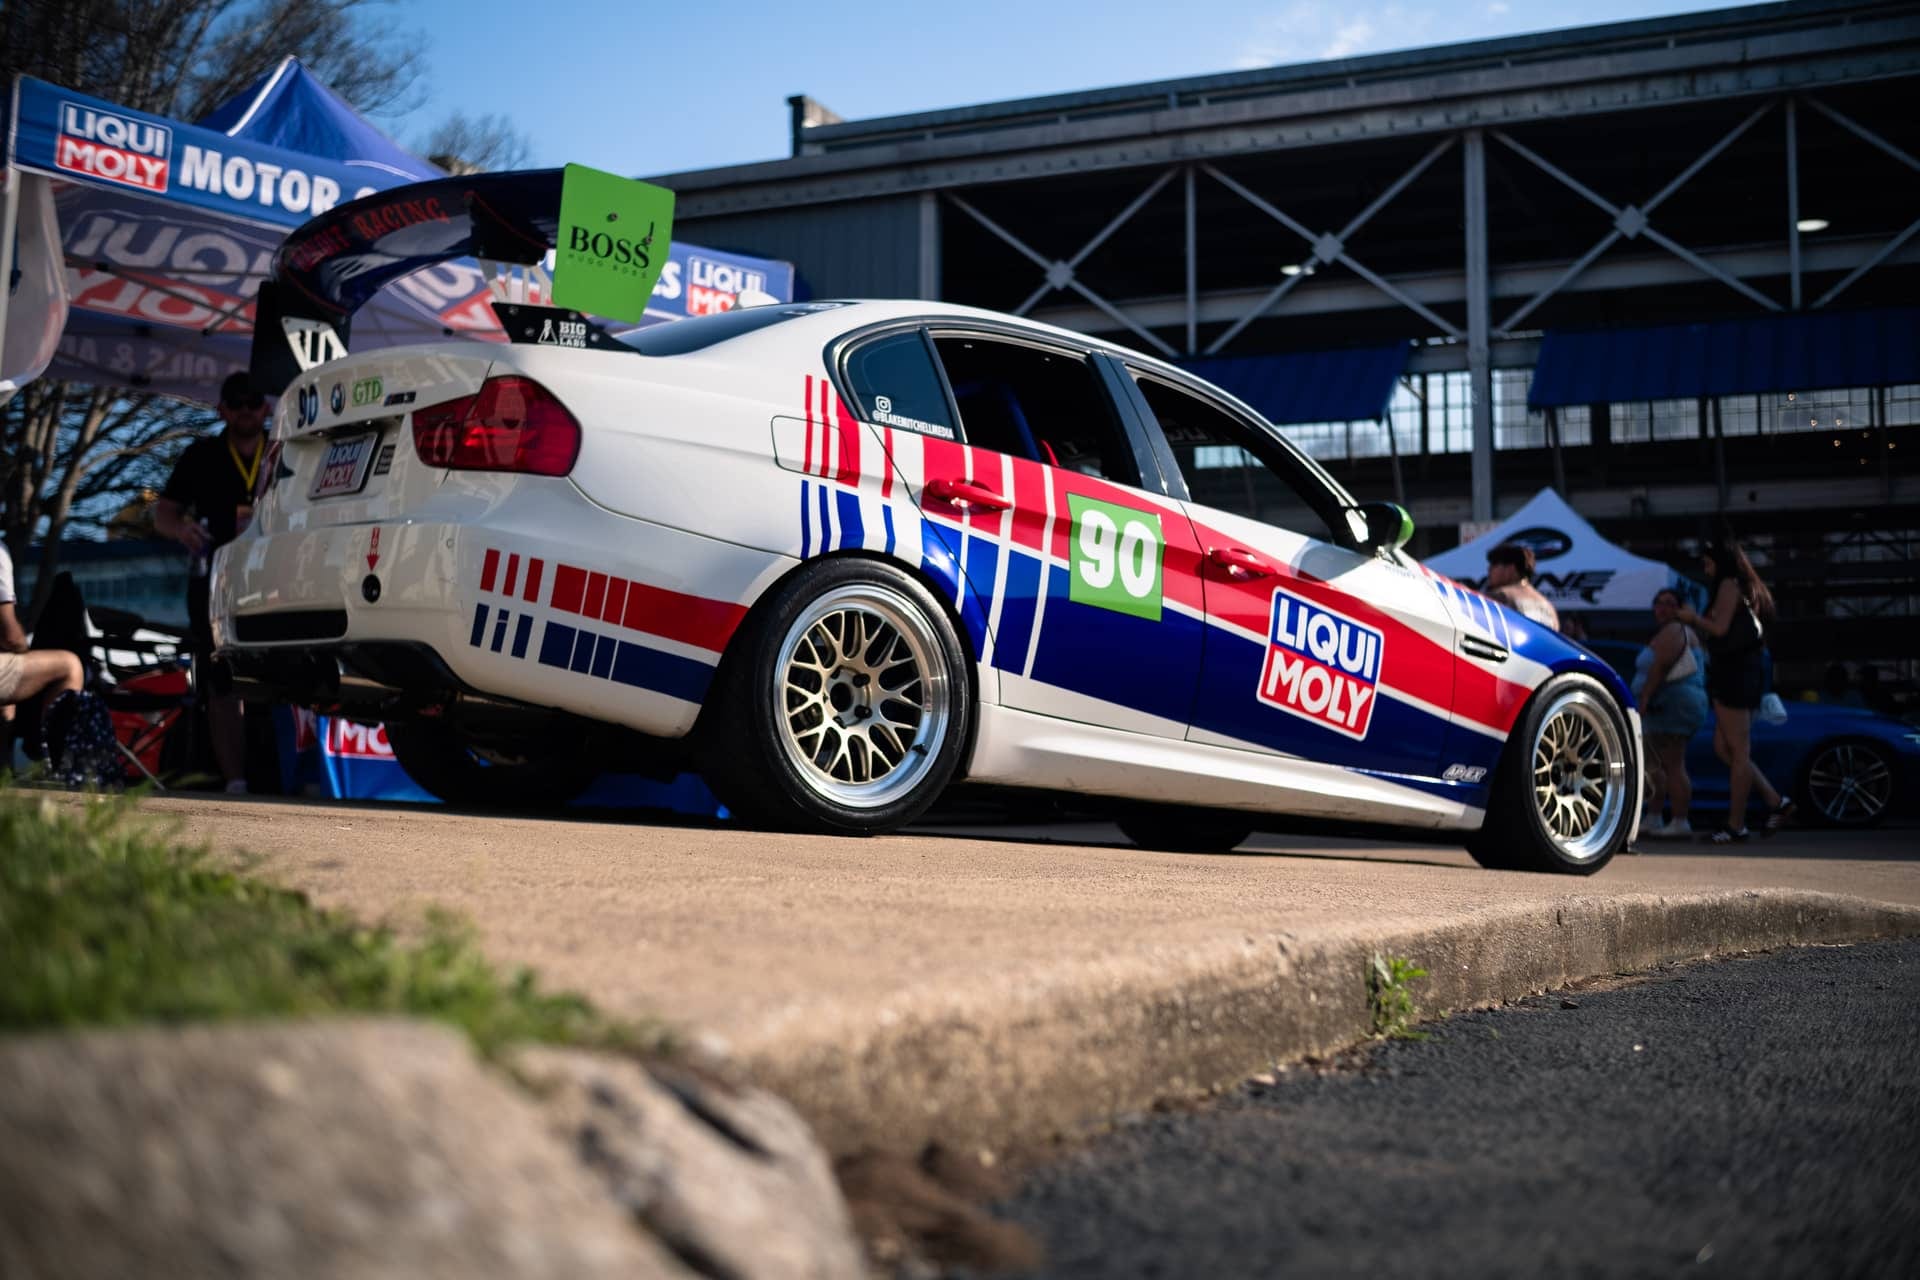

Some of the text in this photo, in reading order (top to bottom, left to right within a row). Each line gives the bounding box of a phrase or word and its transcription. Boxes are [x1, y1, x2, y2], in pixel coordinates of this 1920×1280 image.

[64, 106, 166, 157] LIQUI
[60, 139, 167, 190] MOLY
[180, 144, 341, 218] MOTOR
[569, 225, 650, 269] BOSS
[691, 260, 762, 294] LIQUI
[691, 287, 737, 315] MO
[559, 321, 587, 336] BIG
[559, 337, 587, 348] LABS
[297, 383, 319, 429] 90
[353, 379, 382, 404] GTD
[1078, 508, 1159, 599] 90
[1275, 597, 1378, 679] LIQUI
[1265, 650, 1375, 730] MOLY
[334, 717, 395, 754] MO
